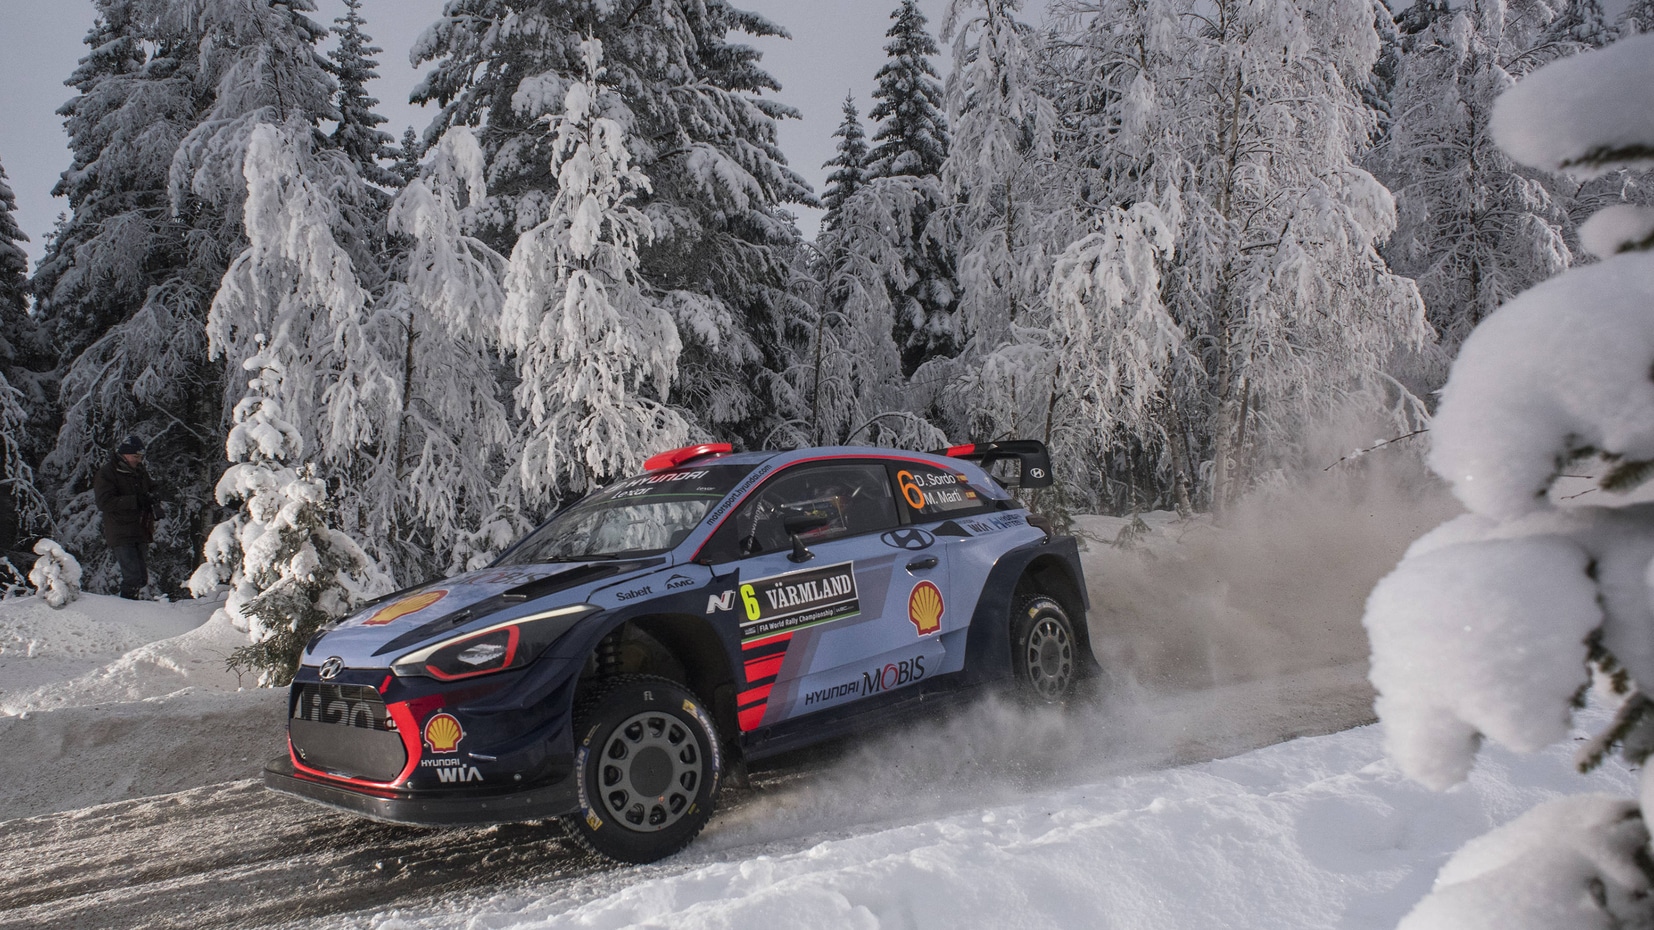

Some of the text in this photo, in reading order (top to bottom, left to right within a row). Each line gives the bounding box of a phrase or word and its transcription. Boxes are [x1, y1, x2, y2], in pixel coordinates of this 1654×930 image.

[625, 470, 709, 488] HYUNDAI
[914, 473, 956, 487] D. Sordo
[611, 487, 653, 499] Lexar
[706, 464, 772, 526] motorsport.hyundai.com
[897, 470, 925, 509] 6
[924, 488, 962, 505] M. Martí
[616, 586, 653, 601] Sabelt
[666, 580, 695, 590] AMG
[765, 574, 852, 610] VÄRMLAND
[740, 584, 761, 621] 6
[760, 608, 834, 632] FIA World Rally Championship
[805, 655, 925, 705] HYUNDAI MOBIS
[420, 758, 460, 767] HYUNDAI
[436, 763, 484, 783] WIA
